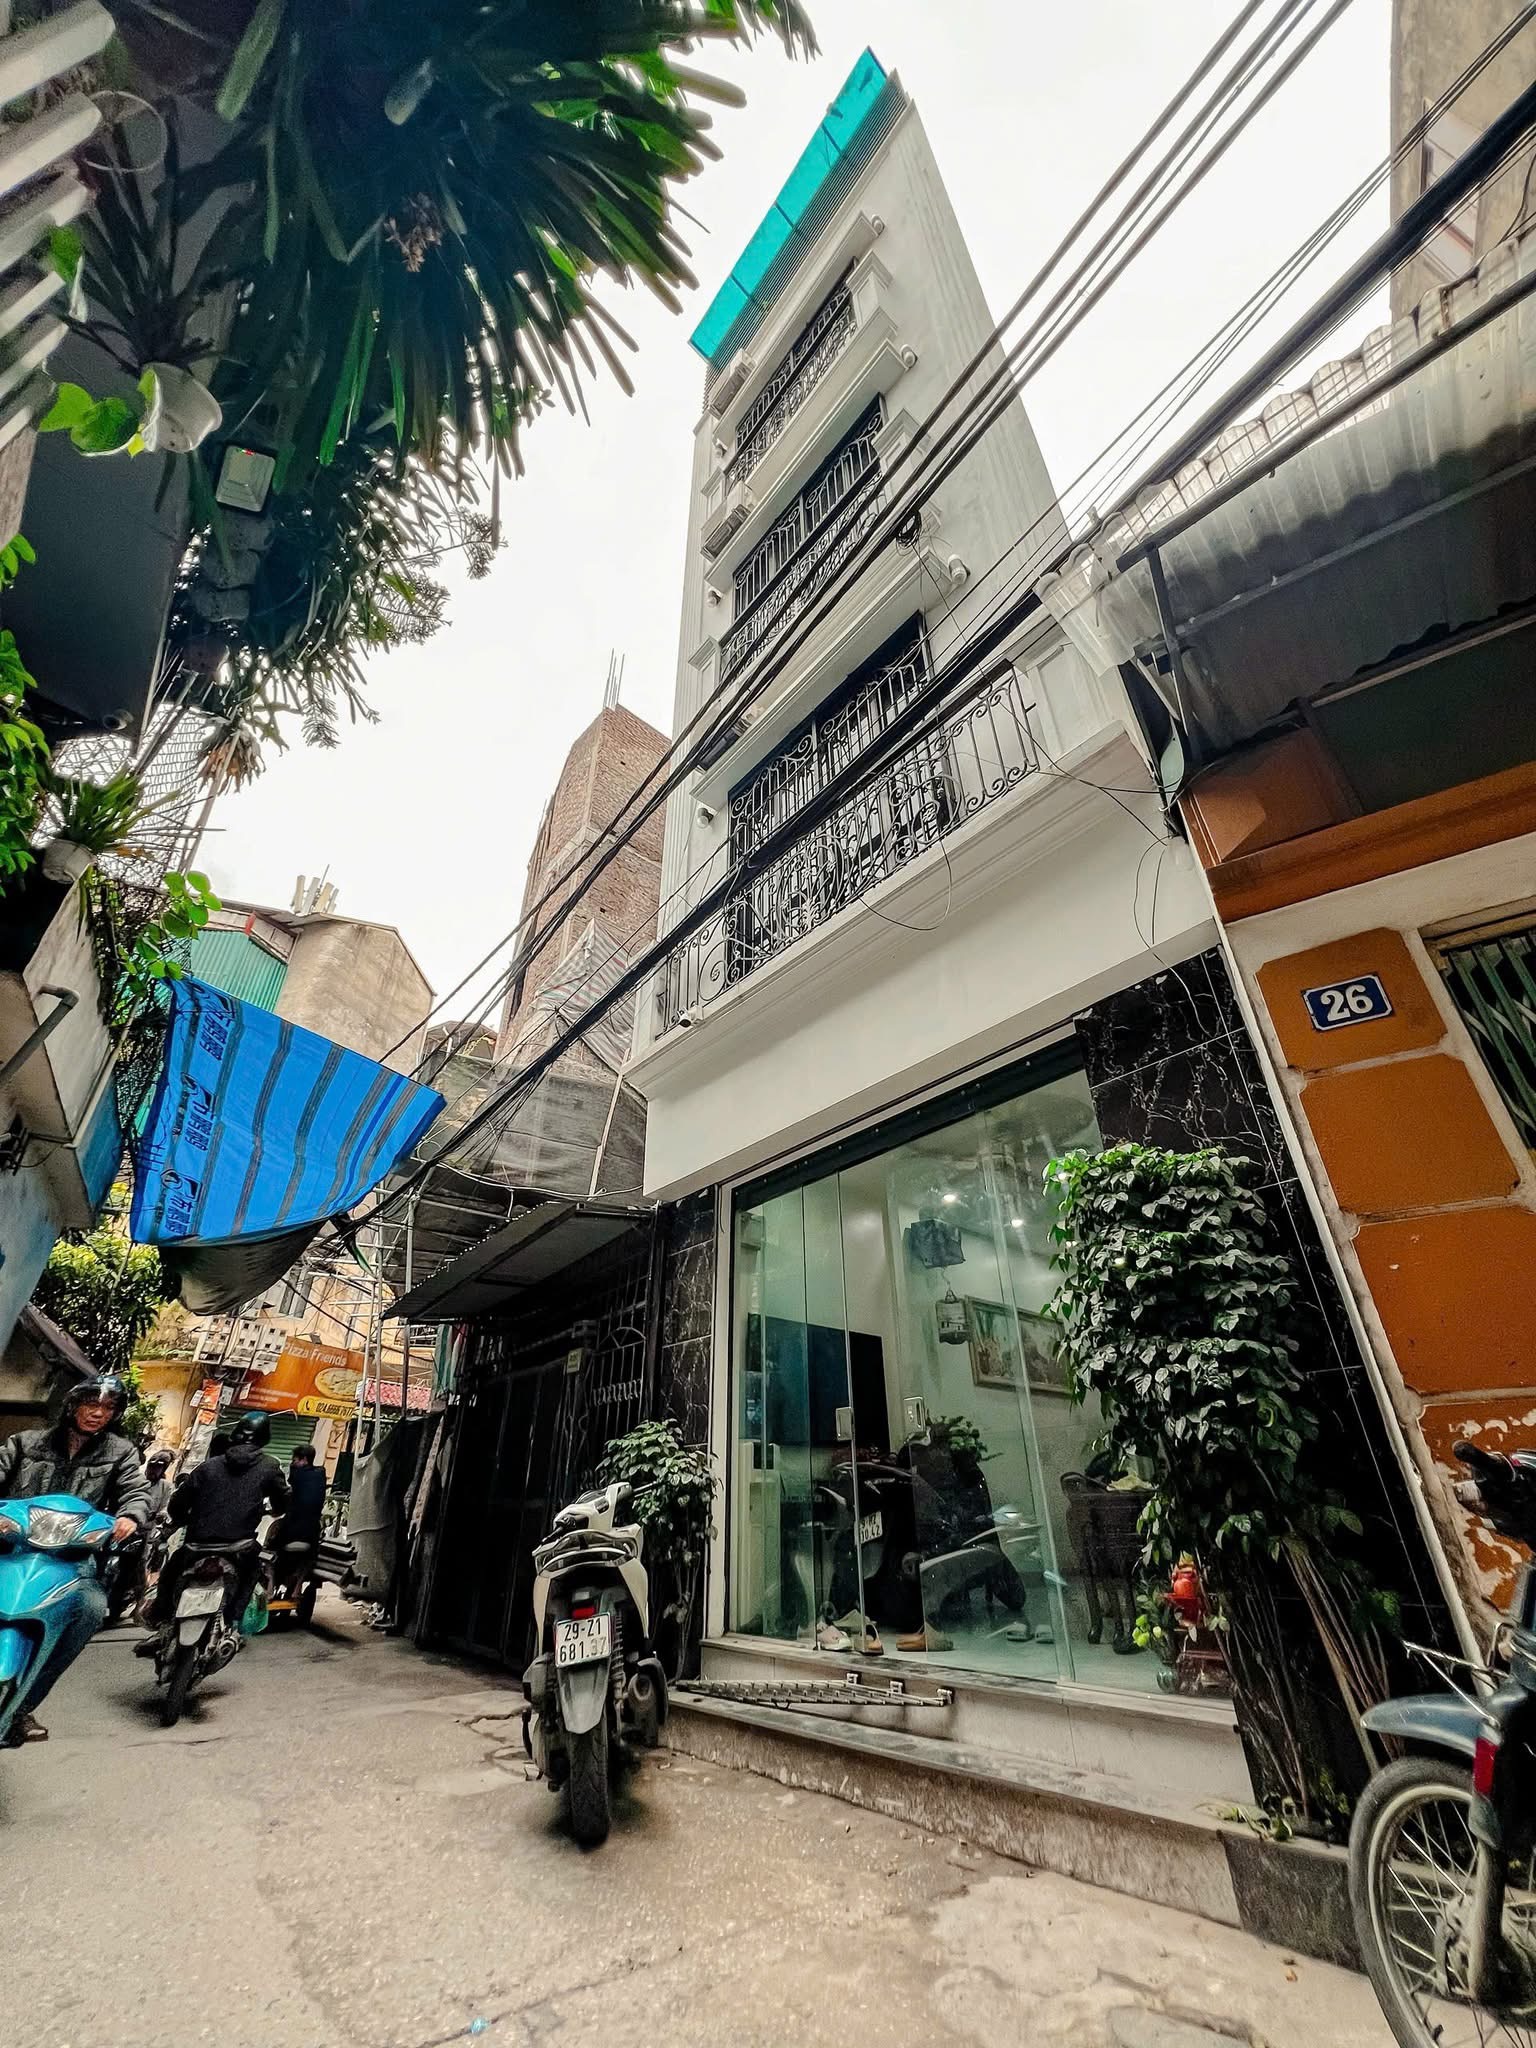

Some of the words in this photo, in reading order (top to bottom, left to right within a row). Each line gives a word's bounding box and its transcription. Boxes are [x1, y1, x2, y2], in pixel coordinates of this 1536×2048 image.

[1320, 984, 1373, 1022] 26
[564, 1617, 601, 1642] 29-Z1
[560, 1636, 607, 1664] 681.37
